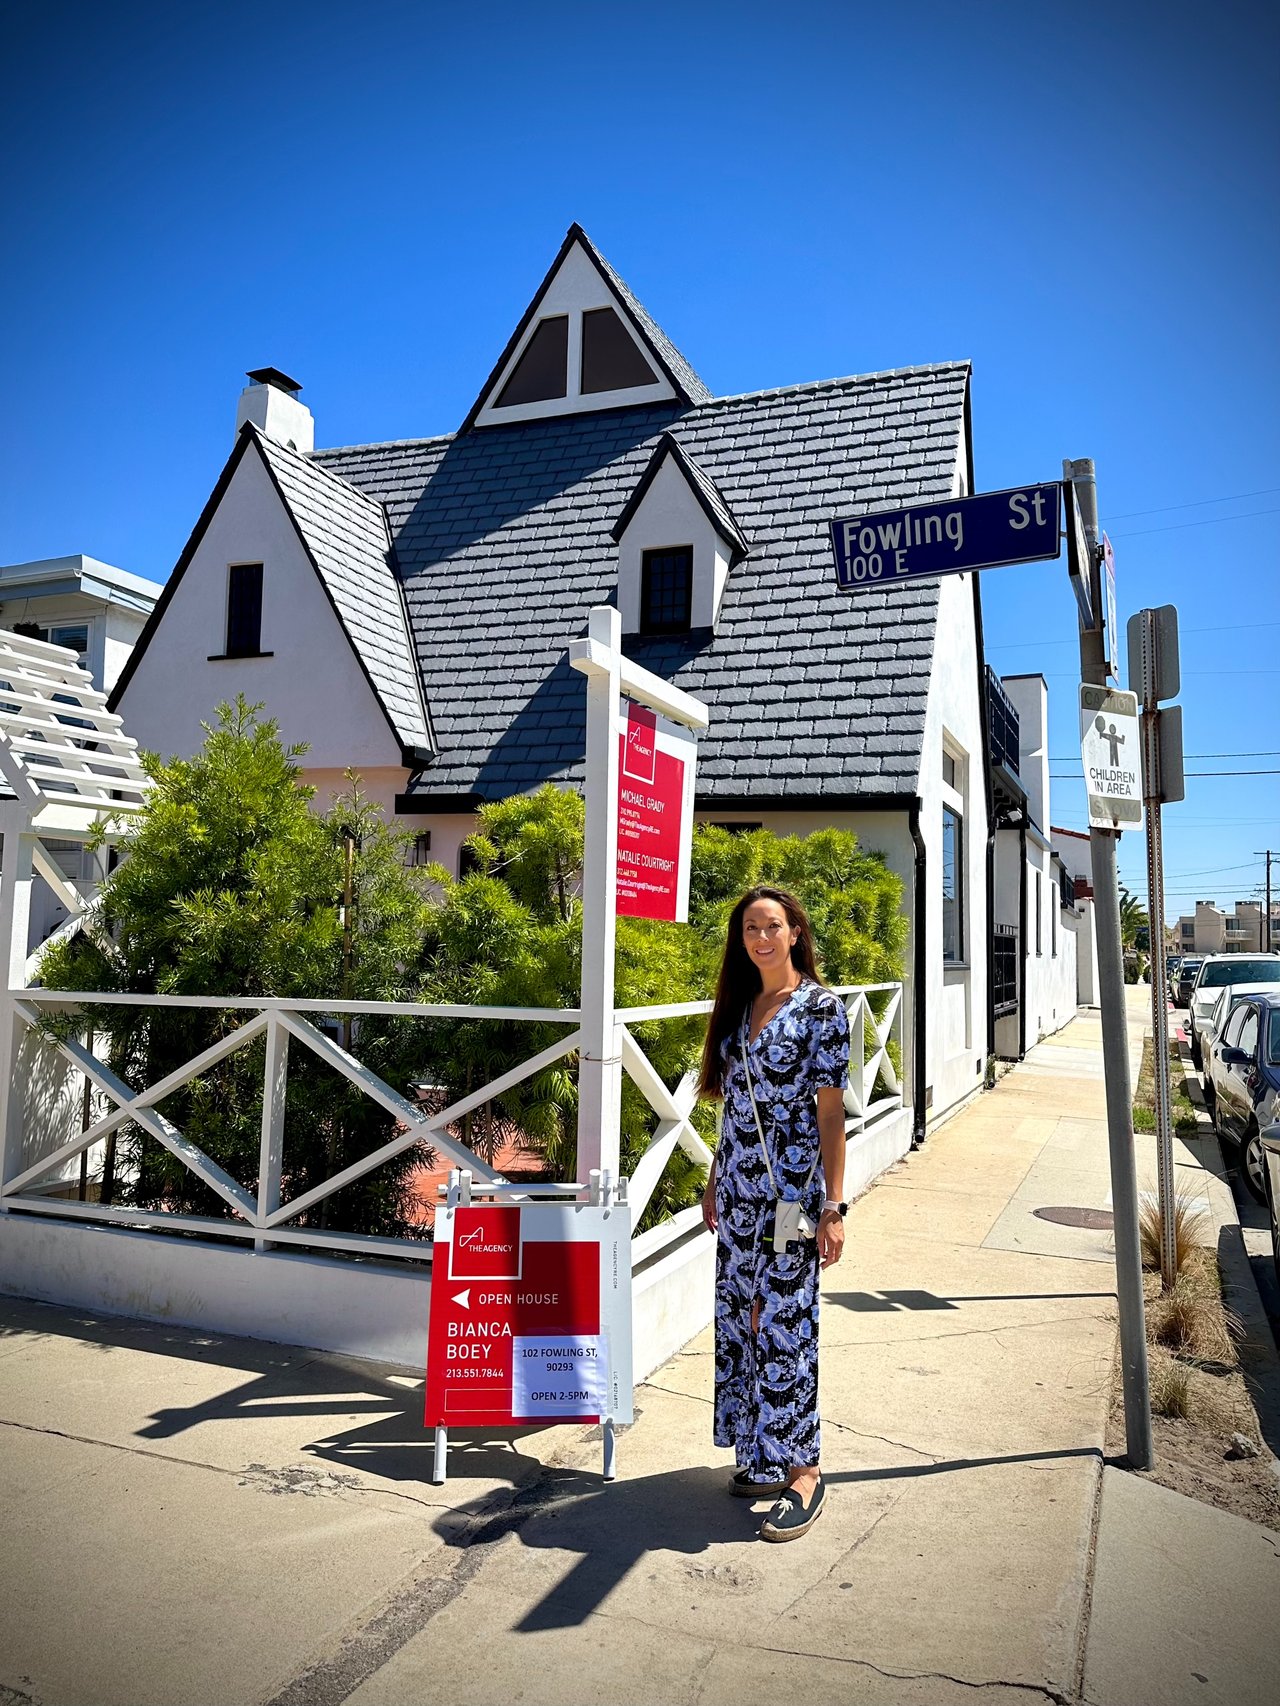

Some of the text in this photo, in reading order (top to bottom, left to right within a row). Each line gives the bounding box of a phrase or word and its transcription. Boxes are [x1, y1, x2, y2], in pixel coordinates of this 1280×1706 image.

[843, 491, 1047, 556] Fowling St
[845, 550, 909, 581] 100 E
[1089, 767, 1135, 783] CHILDREN
[1094, 780, 1132, 796] IN AREA
[621, 788, 665, 814] MICHAEL GRADY
[617, 848, 675, 872] NATALIE COURTRIGHT
[479, 1293, 559, 1305] OPEN HOUSE
[447, 1322, 512, 1337] BIANCA
[446, 1344, 492, 1359] BOEY
[522, 1347, 598, 1358] 102 FOWLING ST,
[446, 1368, 504, 1378] 213.551.7844
[546, 1362, 574, 1372] 90293
[531, 1391, 589, 1401] OPEN 2-5PM
